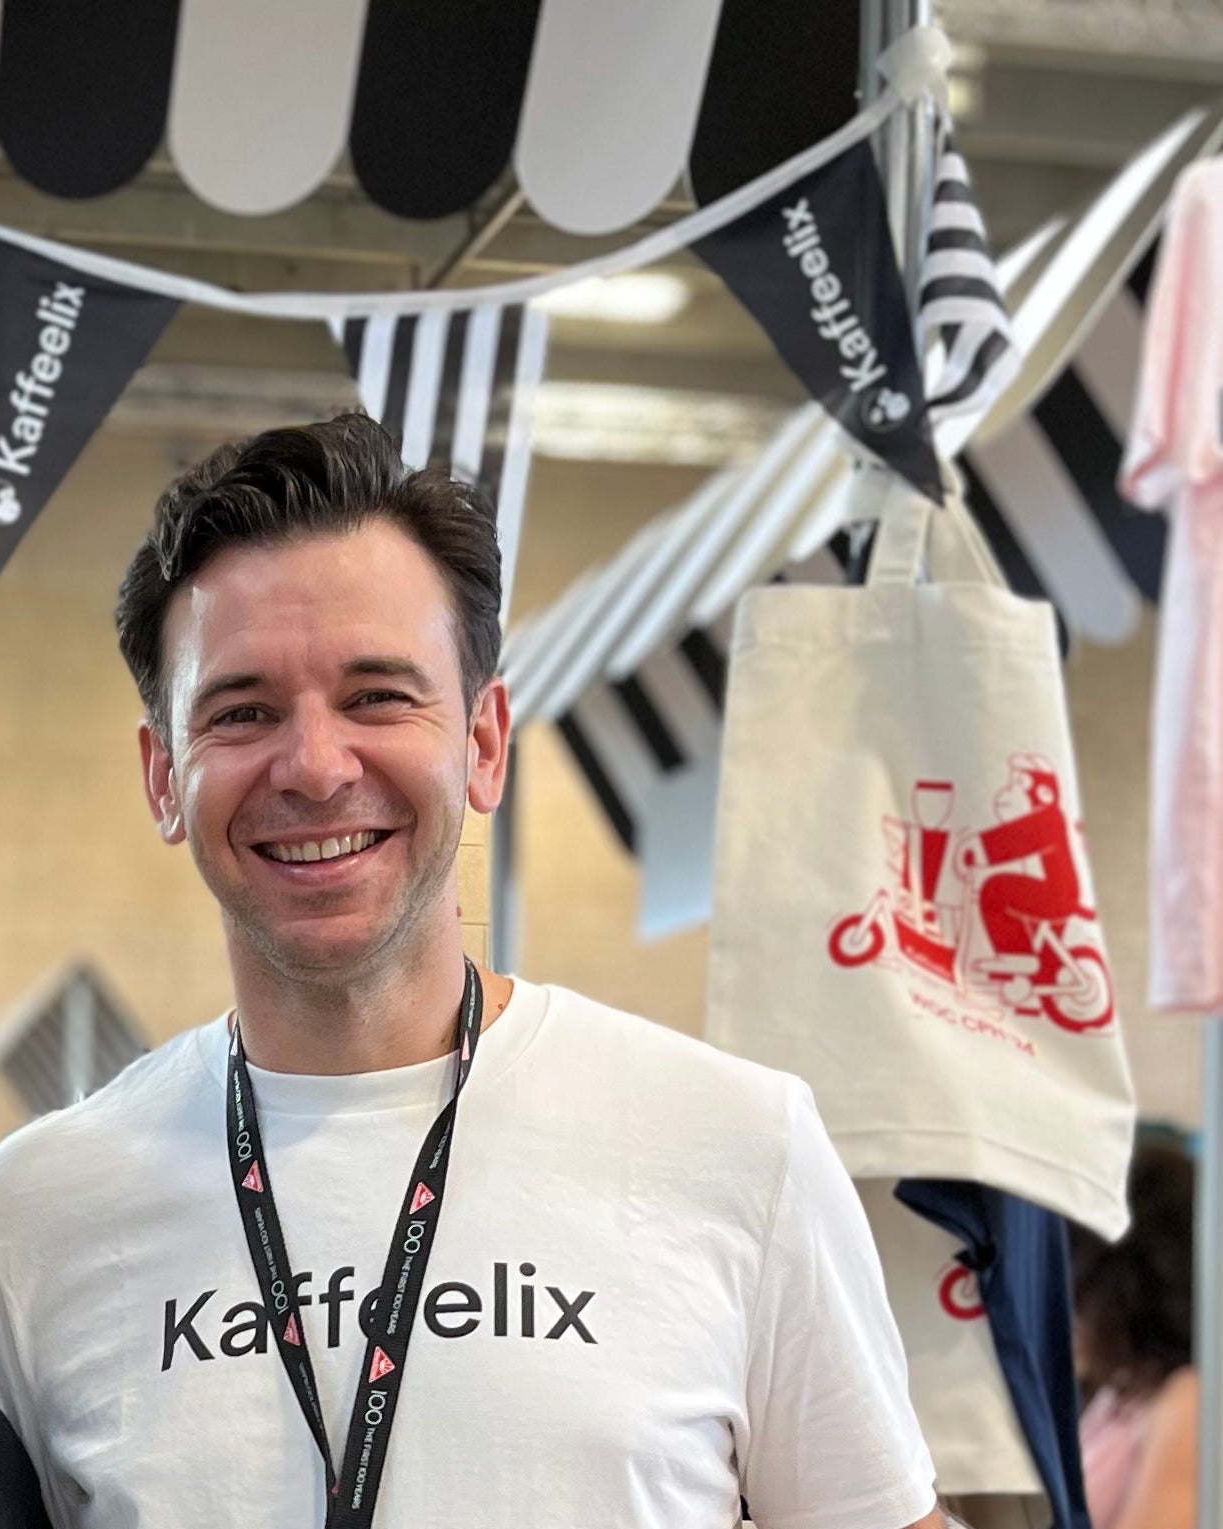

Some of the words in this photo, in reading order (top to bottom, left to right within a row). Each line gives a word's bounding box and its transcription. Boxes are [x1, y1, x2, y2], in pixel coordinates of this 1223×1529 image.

[782, 198, 887, 392] Kaffeelix
[237, 1132, 253, 1162] 100
[403, 1220, 427, 1254] 100
[401, 1256, 413, 1274] THE
[397, 1272, 409, 1294] FIRST
[271, 1280, 289, 1316] 100
[387, 1310, 399, 1334] YEARS
[365, 1390, 387, 1424] 100
[363, 1428, 375, 1442] THE
[361, 1444, 371, 1466] FIRST
[351, 1482, 363, 1510] YEARS
